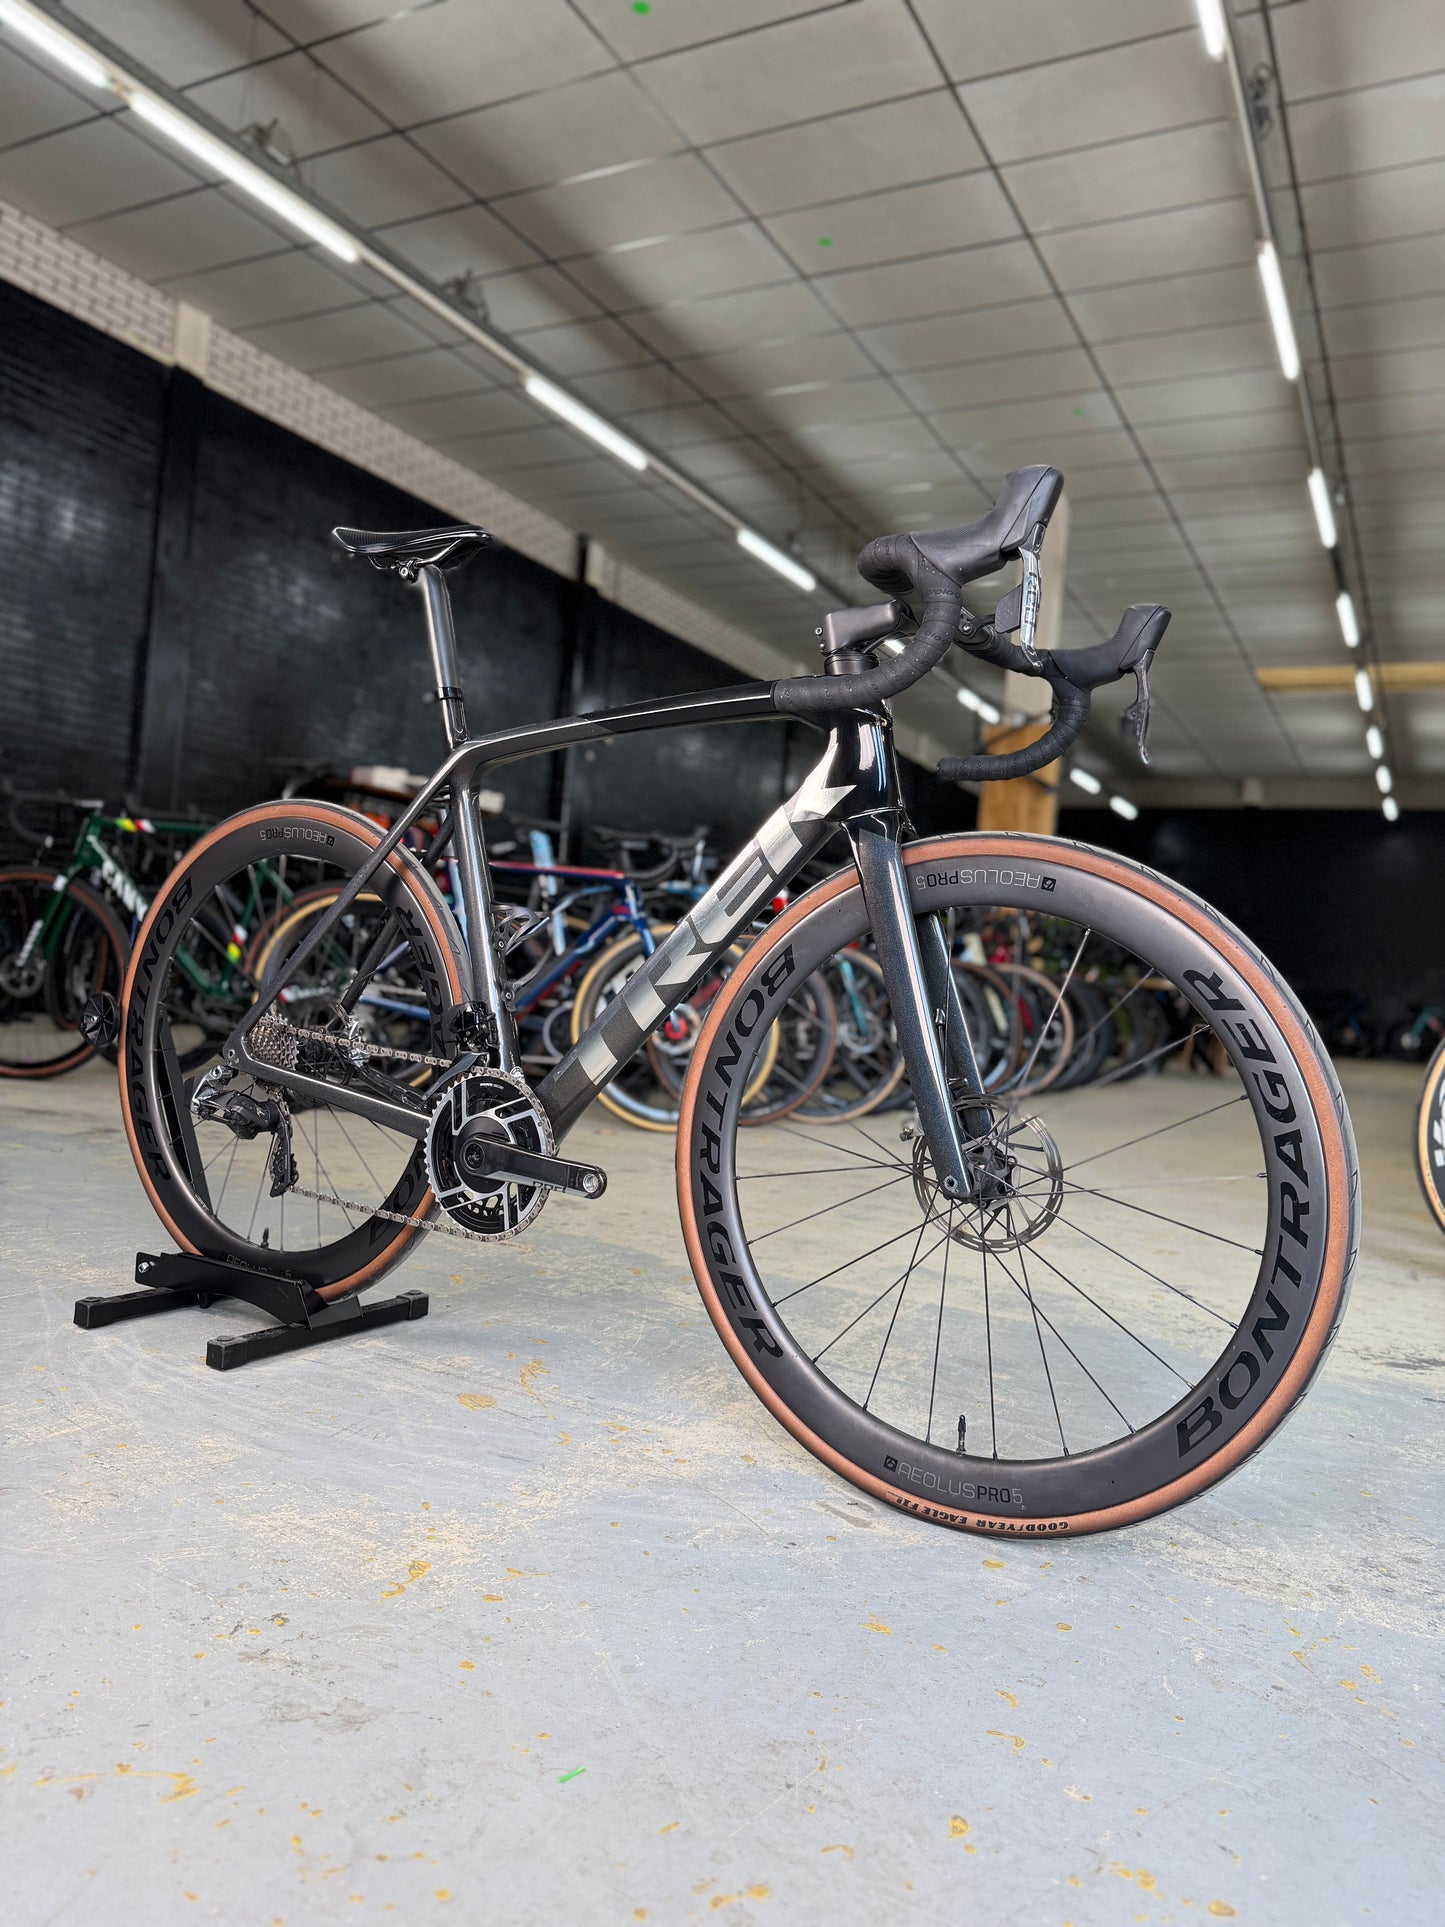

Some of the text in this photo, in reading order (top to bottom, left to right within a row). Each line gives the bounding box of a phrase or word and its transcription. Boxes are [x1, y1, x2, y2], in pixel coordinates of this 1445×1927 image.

[130, 876, 193, 1182] BONTRAGER
[553, 742, 858, 1086] TREK
[699, 943, 796, 1358] BONTRAGER
[1176, 968, 1310, 1458] BONTRAGER
[922, 1507, 968, 1525] EAGLE
[976, 1519, 1069, 1532] GOODYEAR
